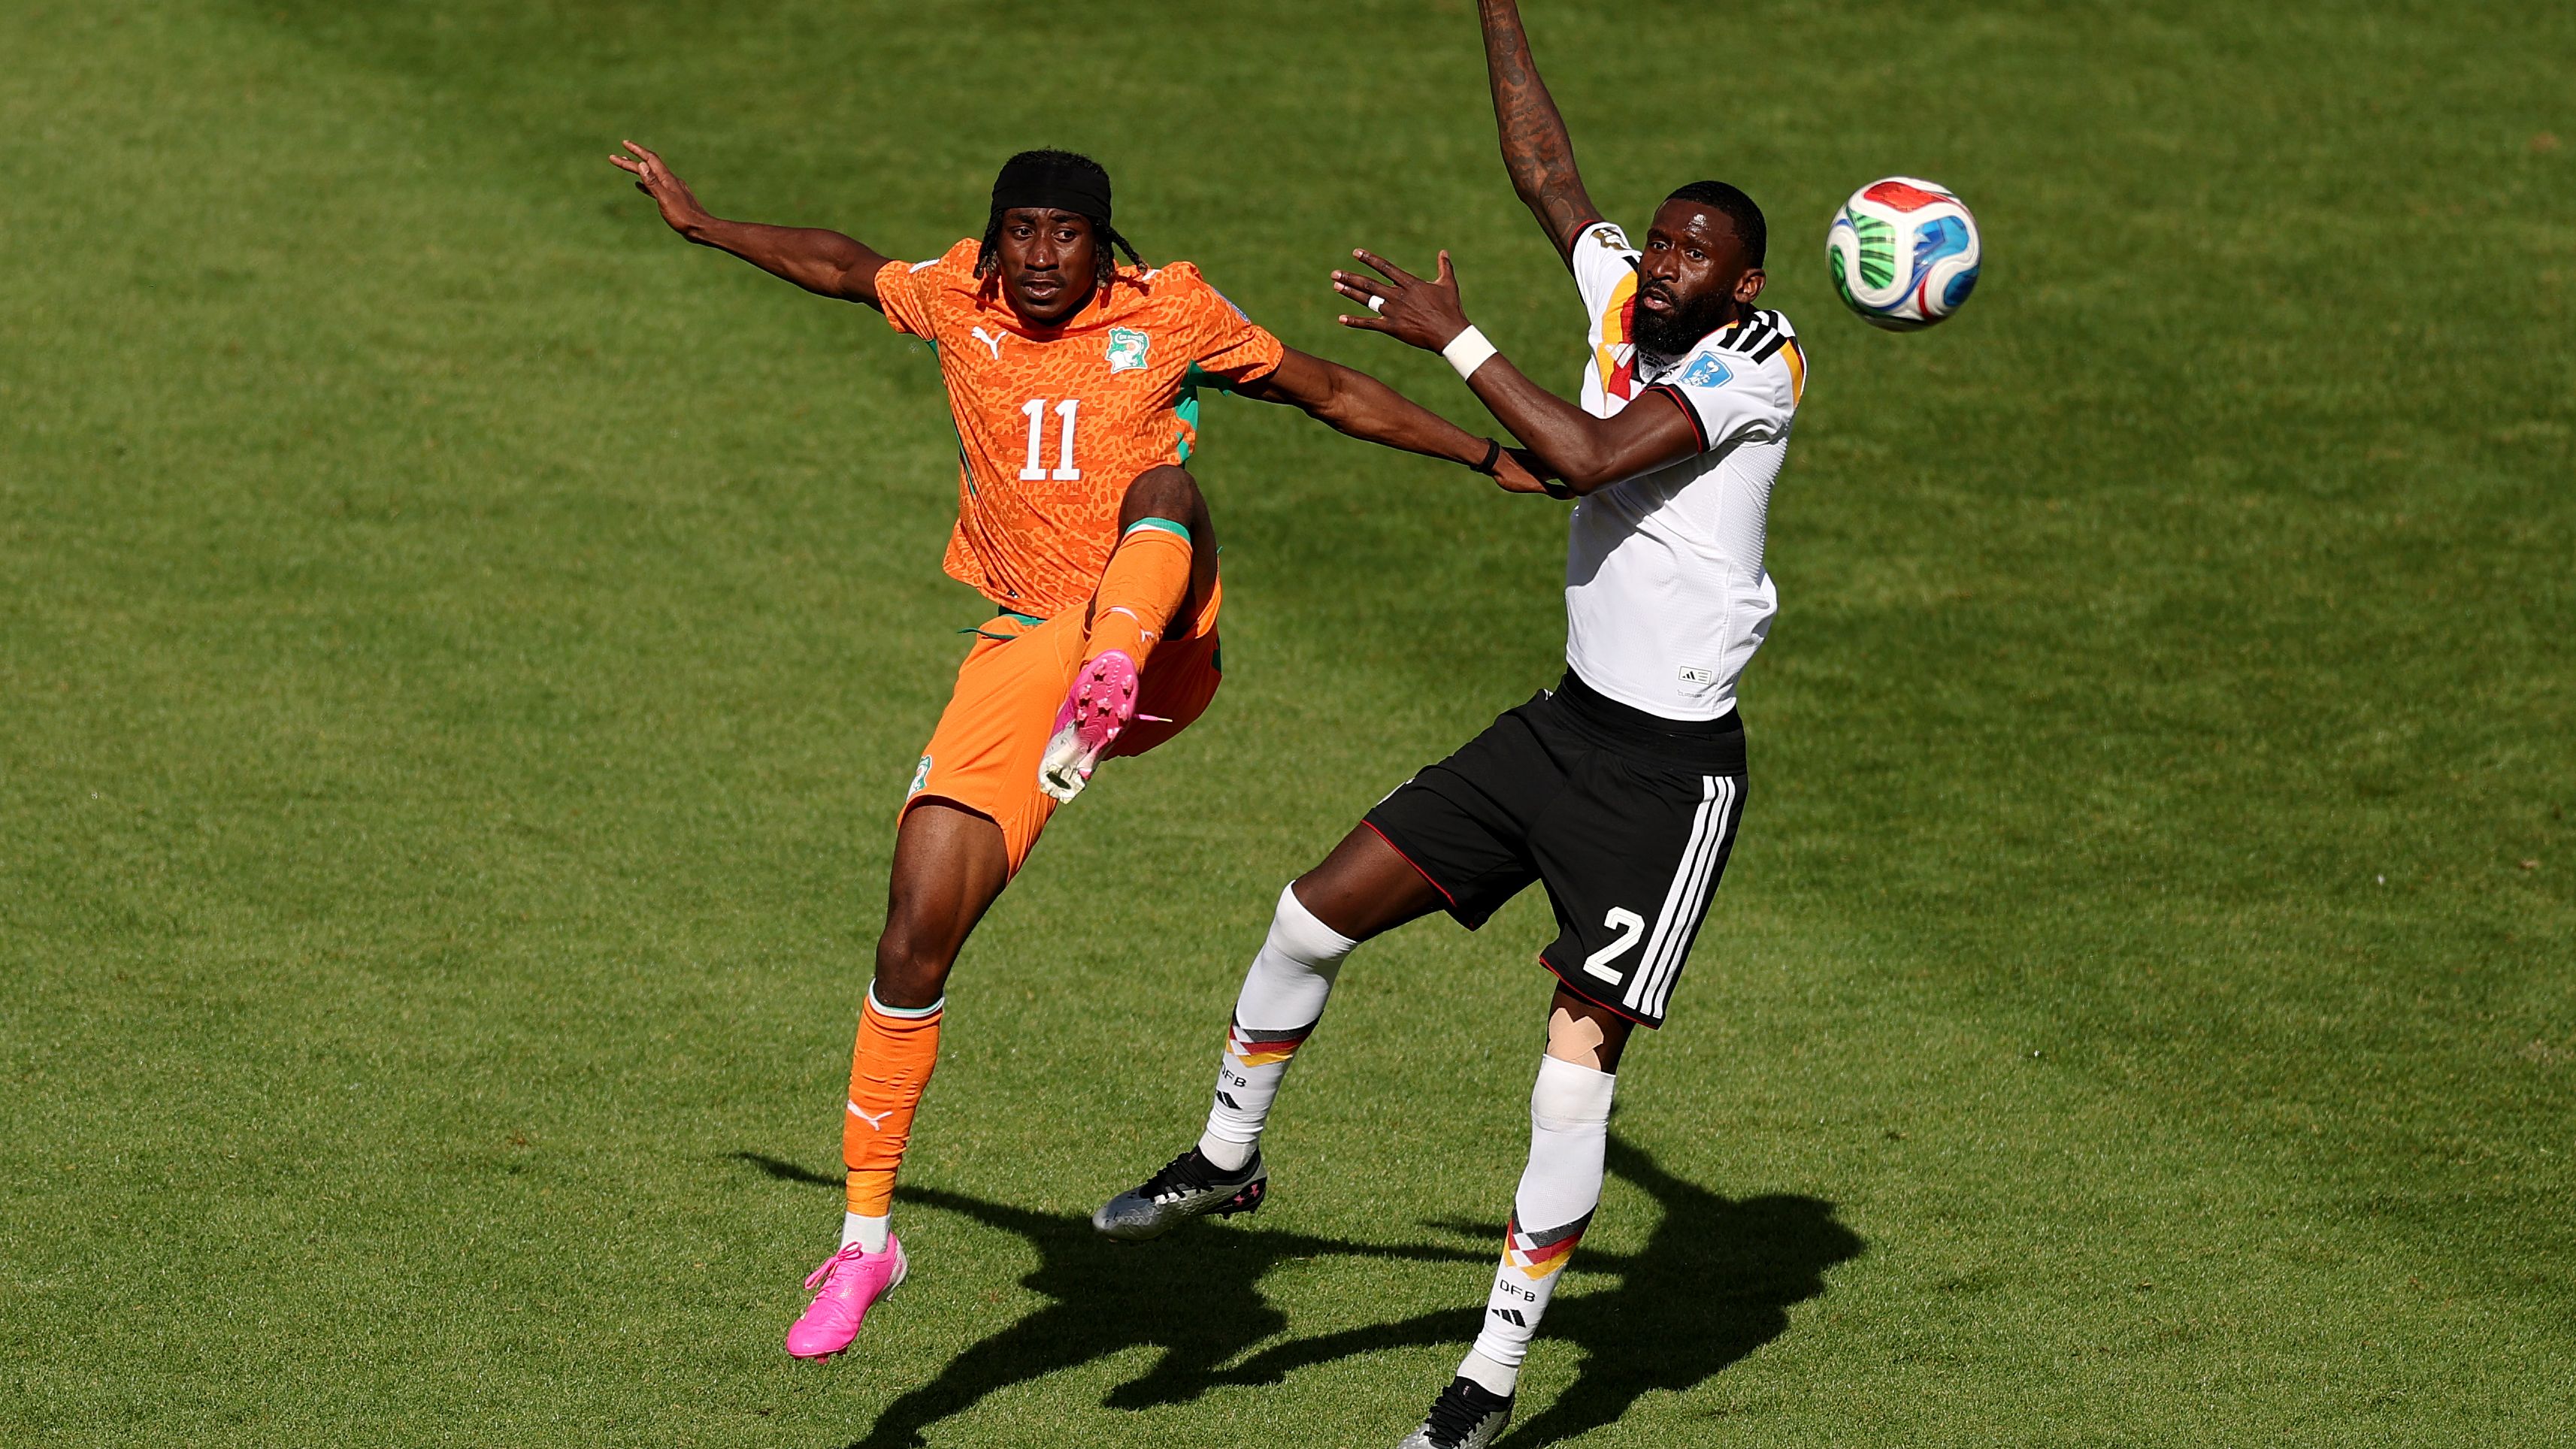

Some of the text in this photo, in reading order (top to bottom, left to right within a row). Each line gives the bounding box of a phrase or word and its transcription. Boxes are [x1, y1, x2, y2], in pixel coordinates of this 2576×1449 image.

[1019, 398, 1081, 481] 11
[1582, 906, 1645, 986] 2
[1500, 1279, 1536, 1302] DFB
